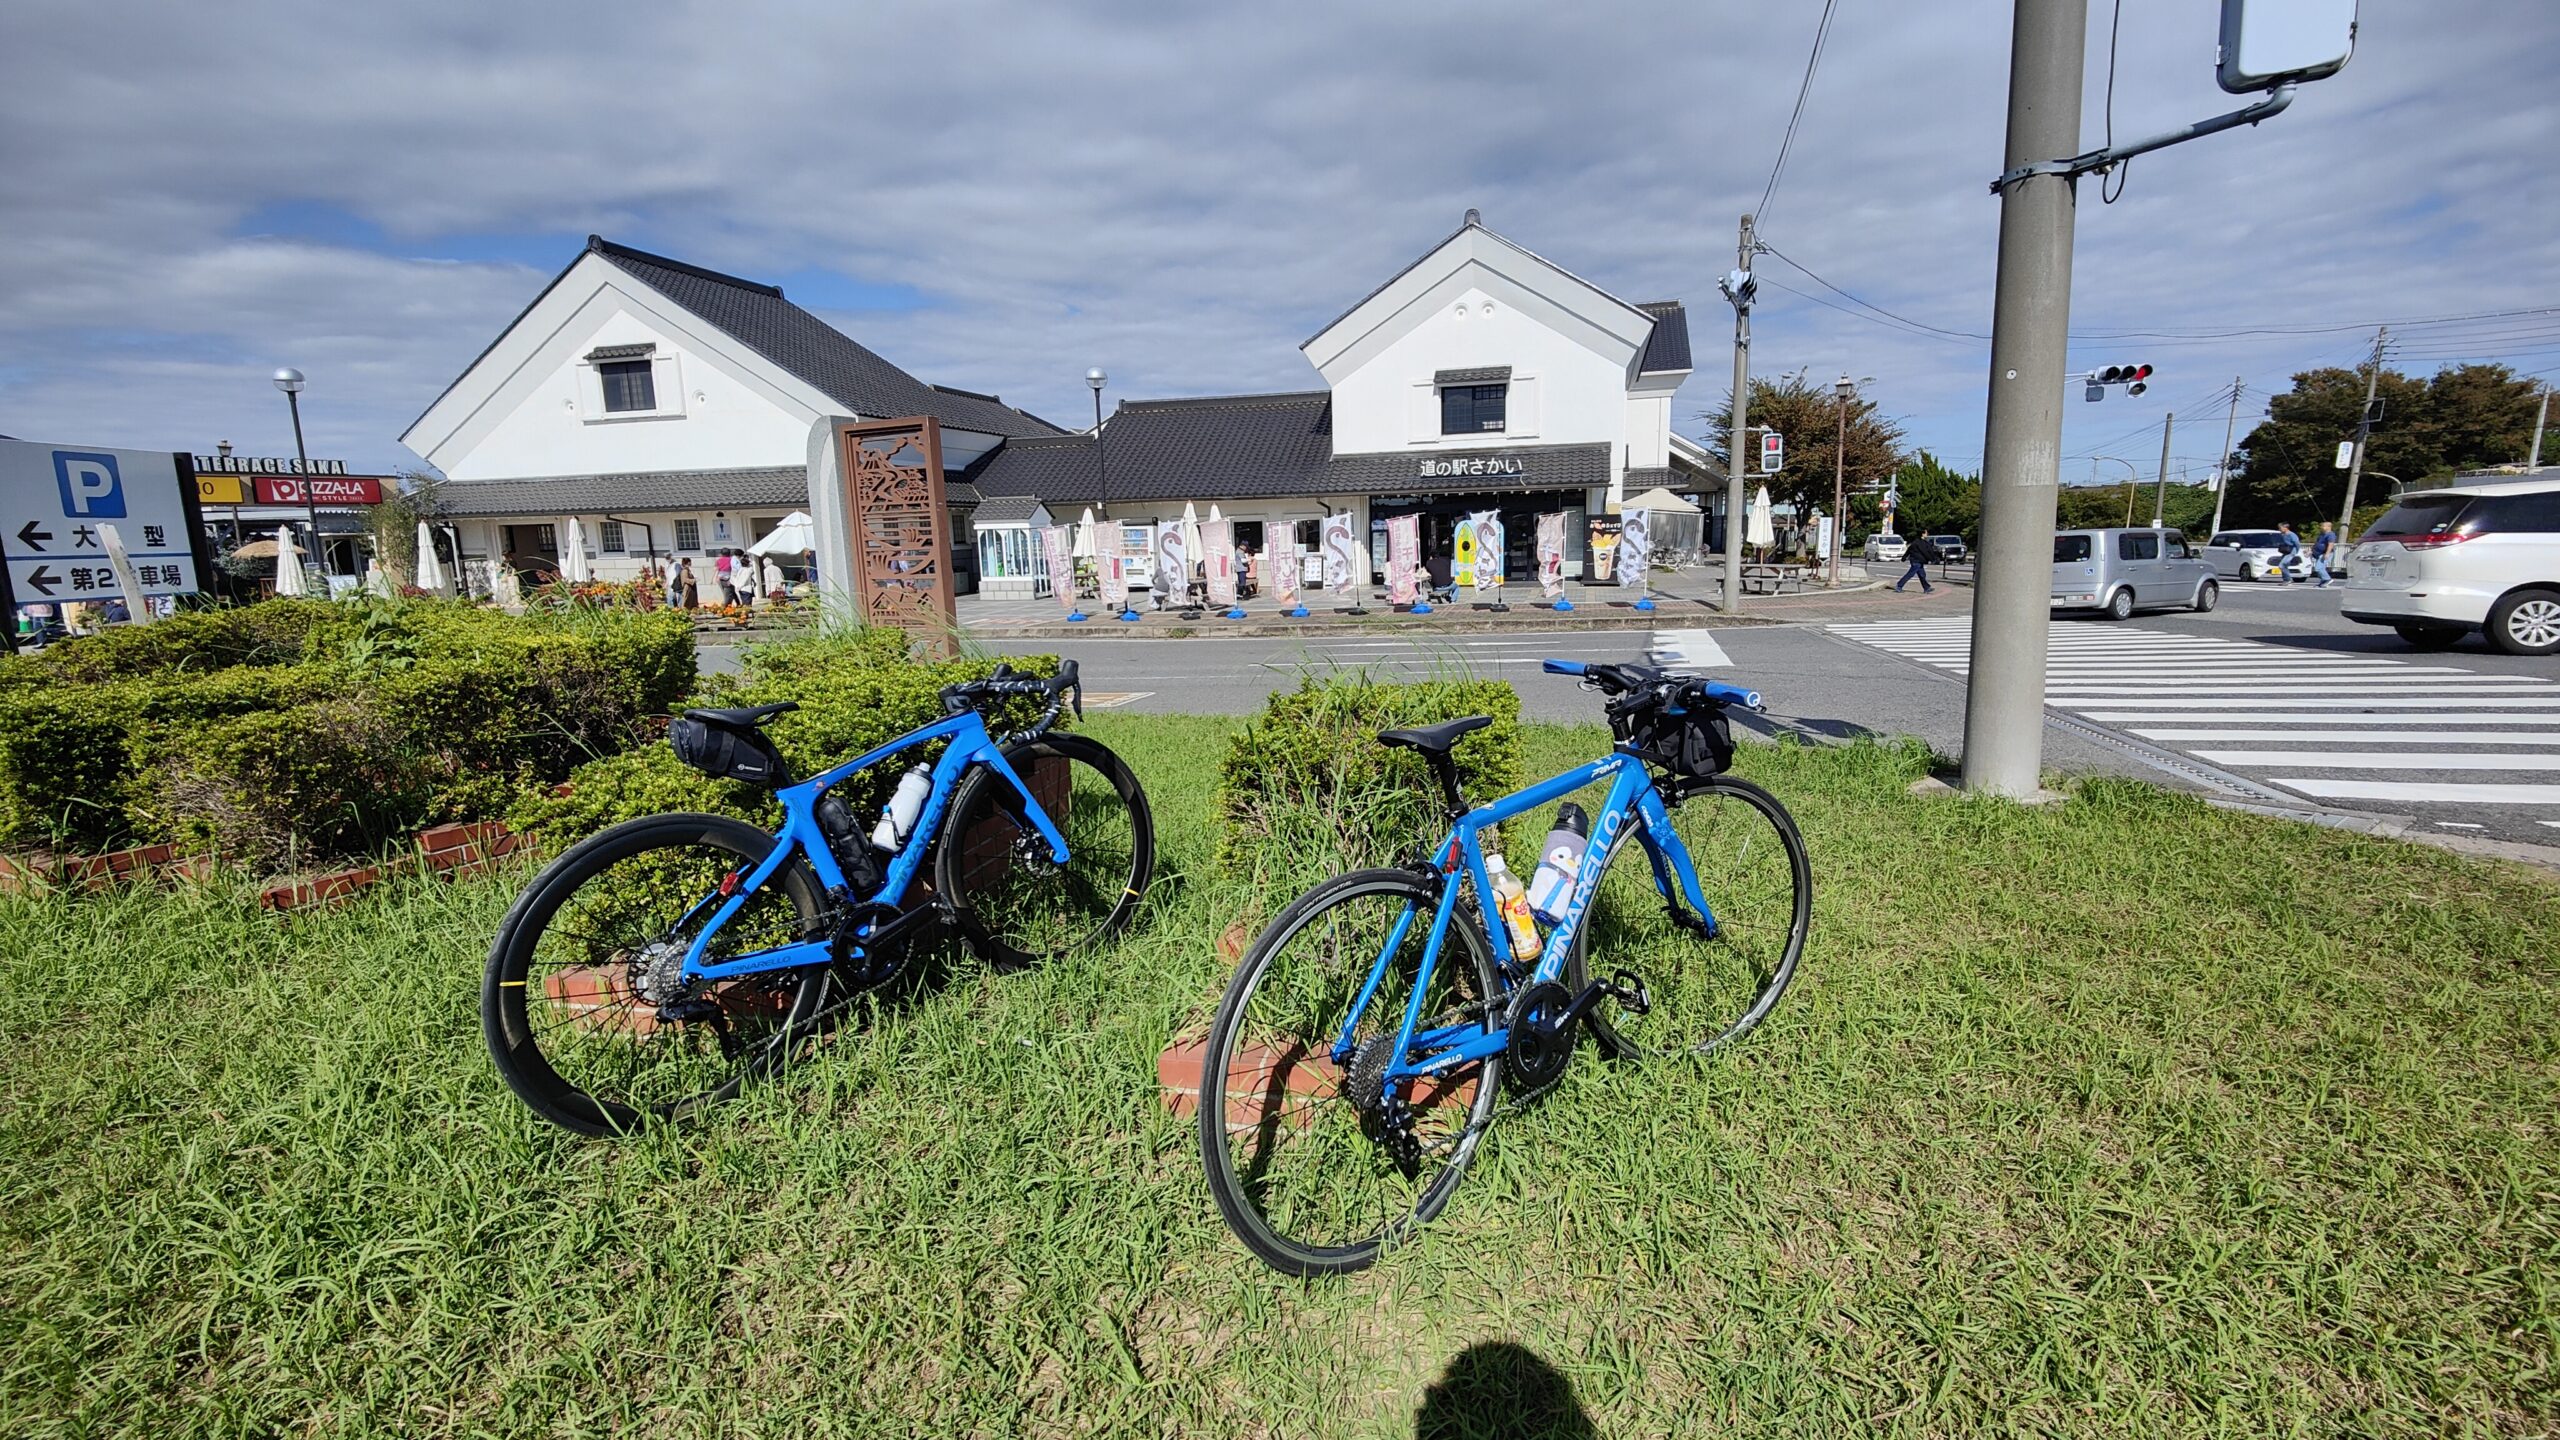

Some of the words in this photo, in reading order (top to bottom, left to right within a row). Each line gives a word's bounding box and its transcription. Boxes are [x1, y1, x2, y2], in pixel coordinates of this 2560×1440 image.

[197, 456, 286, 474] TERRACE
[294, 457, 348, 475] SAKAI
[1420, 457, 1523, 477] 道の駅さかい
[65, 459, 113, 513] P
[70, 565, 182, 591] 第2車場
[882, 766, 960, 898] PINARELLO
[1543, 809, 1622, 981] PINARELLO
[731, 955, 791, 973] PINARELLO
[1421, 1053, 1463, 1075] PINARELLO
